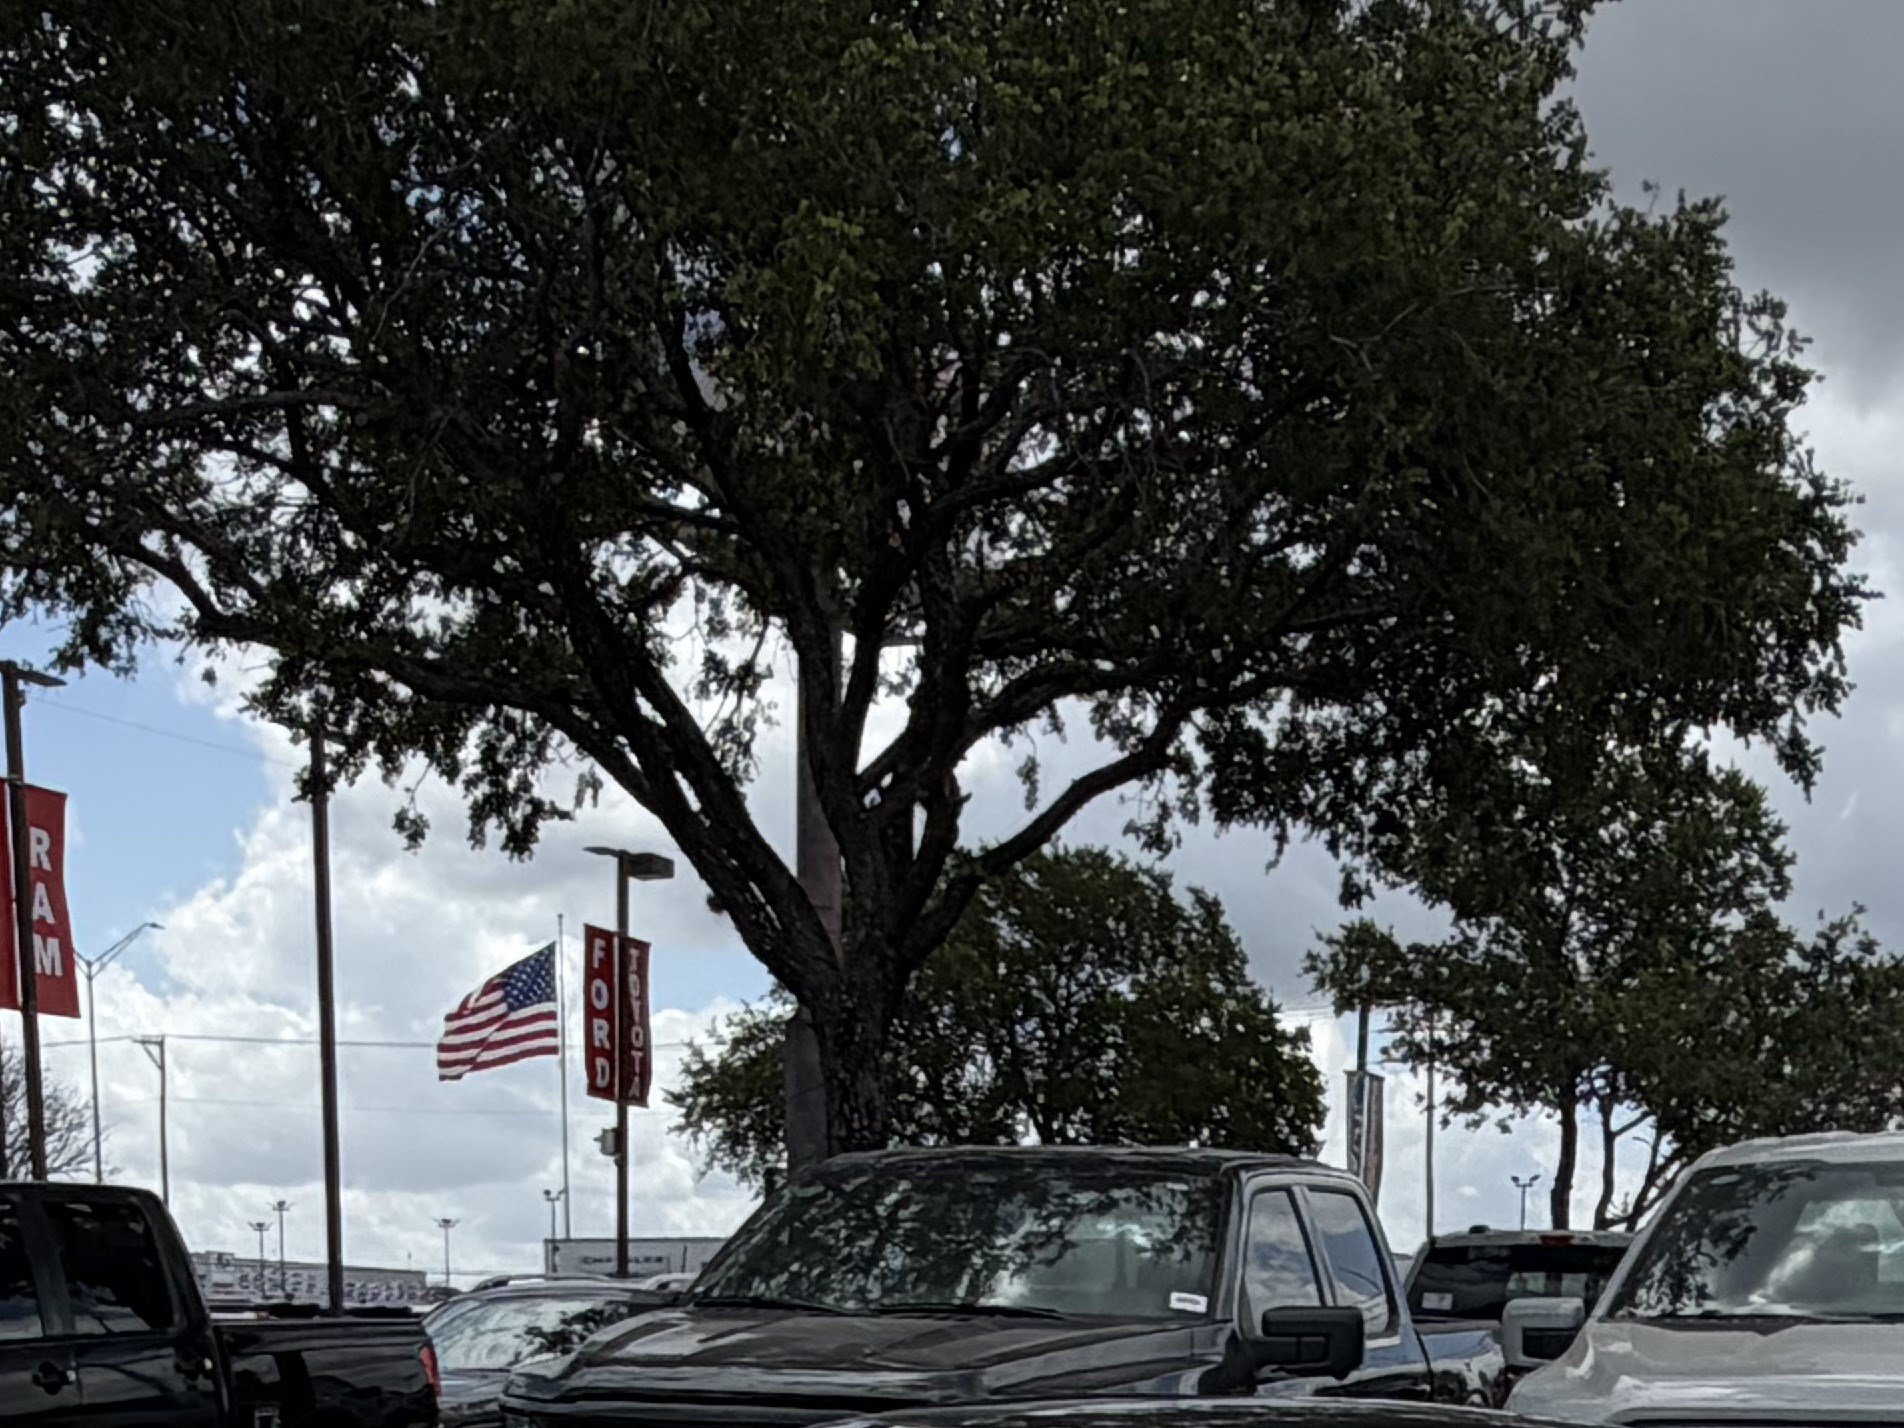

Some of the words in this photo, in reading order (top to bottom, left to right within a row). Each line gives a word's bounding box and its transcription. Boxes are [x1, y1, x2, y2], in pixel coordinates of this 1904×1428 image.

[29, 827, 63, 977] RAM
[590, 938, 611, 1088] FORD
[627, 948, 645, 1098] TOYOTA
